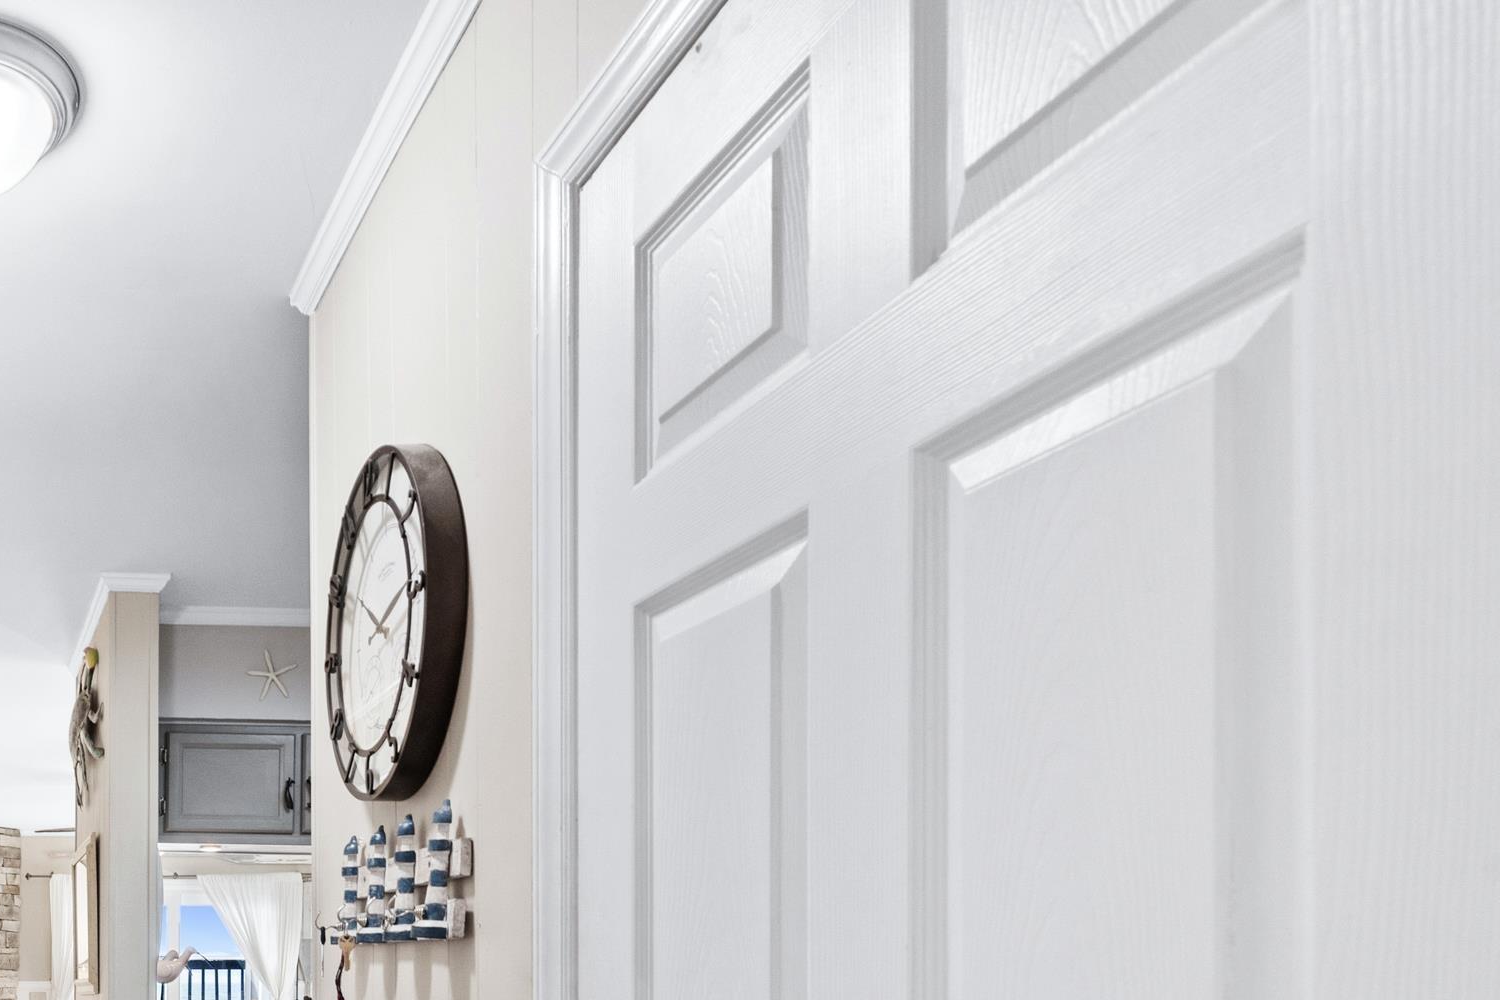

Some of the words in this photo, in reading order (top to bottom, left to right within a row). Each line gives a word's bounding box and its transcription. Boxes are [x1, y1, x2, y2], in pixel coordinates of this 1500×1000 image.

[400, 489, 416, 538] 2
[407, 570, 426, 599] 3
[402, 658, 420, 688] 4
[331, 709, 343, 740] 8
[386, 719, 399, 763] 5
[365, 751, 375, 795] 6
